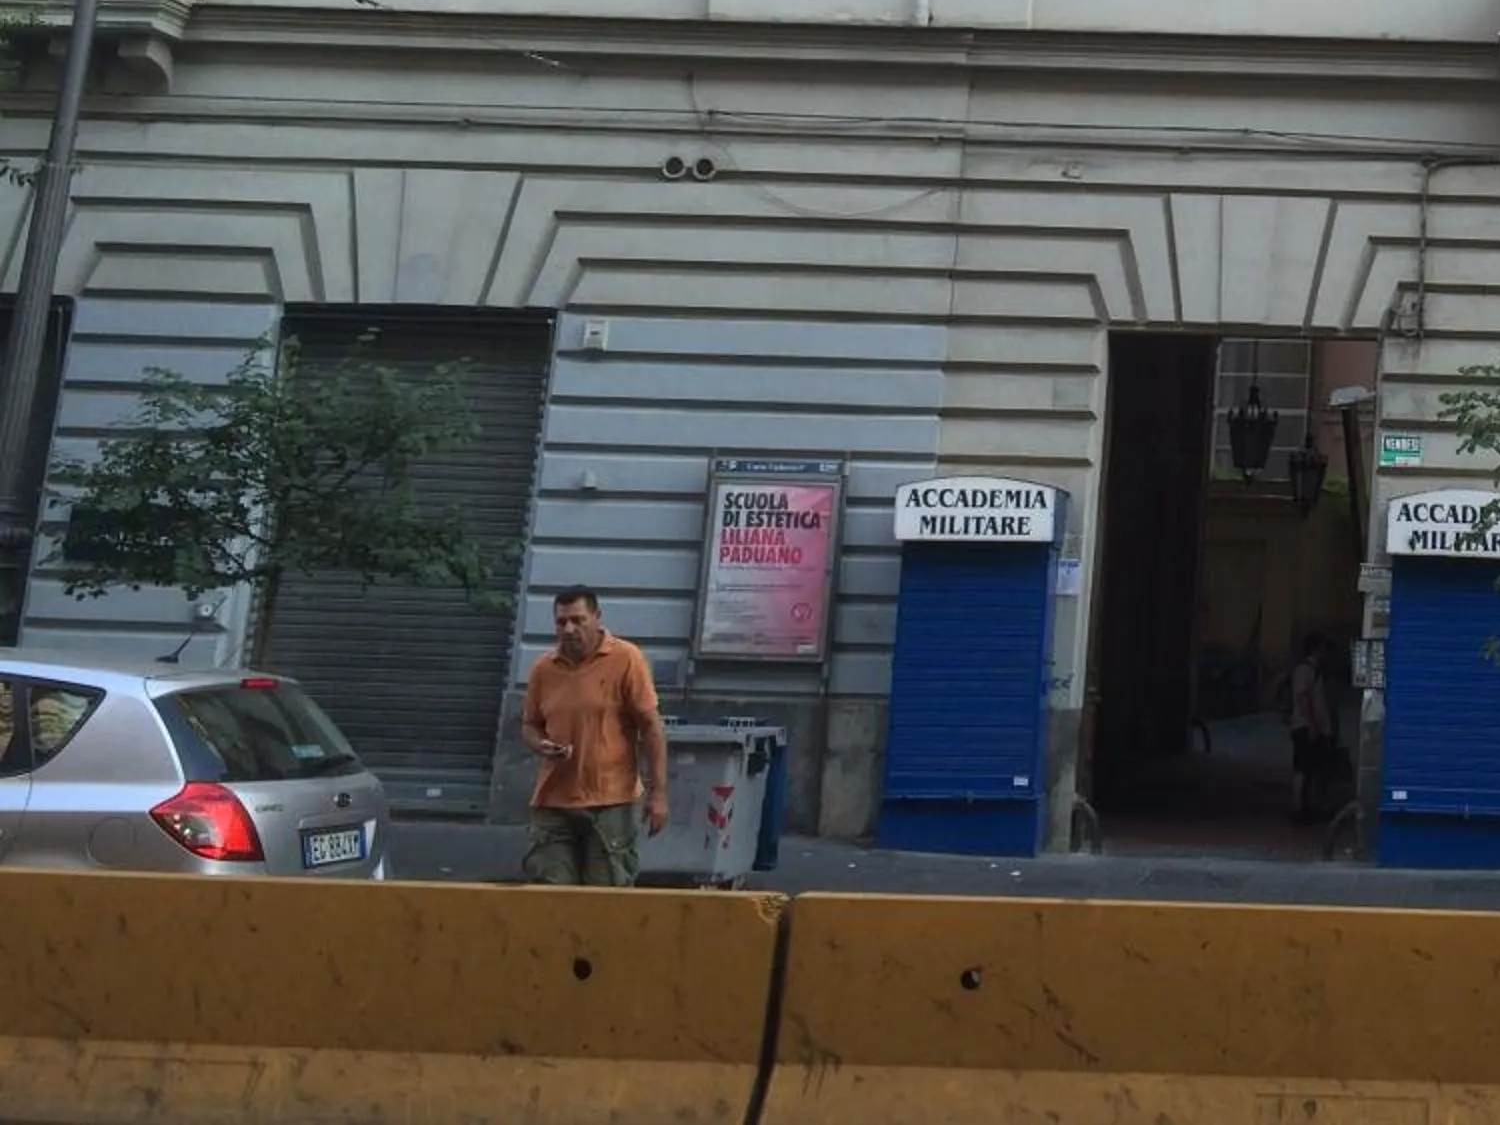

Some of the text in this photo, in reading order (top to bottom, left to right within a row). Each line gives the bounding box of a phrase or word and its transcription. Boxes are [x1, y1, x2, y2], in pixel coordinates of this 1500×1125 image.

[723, 492, 789, 510] SCUOLA
[905, 488, 1048, 509] ACCADEMIA
[723, 511, 821, 529] DI ESTETICA
[919, 515, 1032, 536] MILITARE
[720, 528, 786, 546] LILIANA
[719, 546, 804, 564] PADUANO
